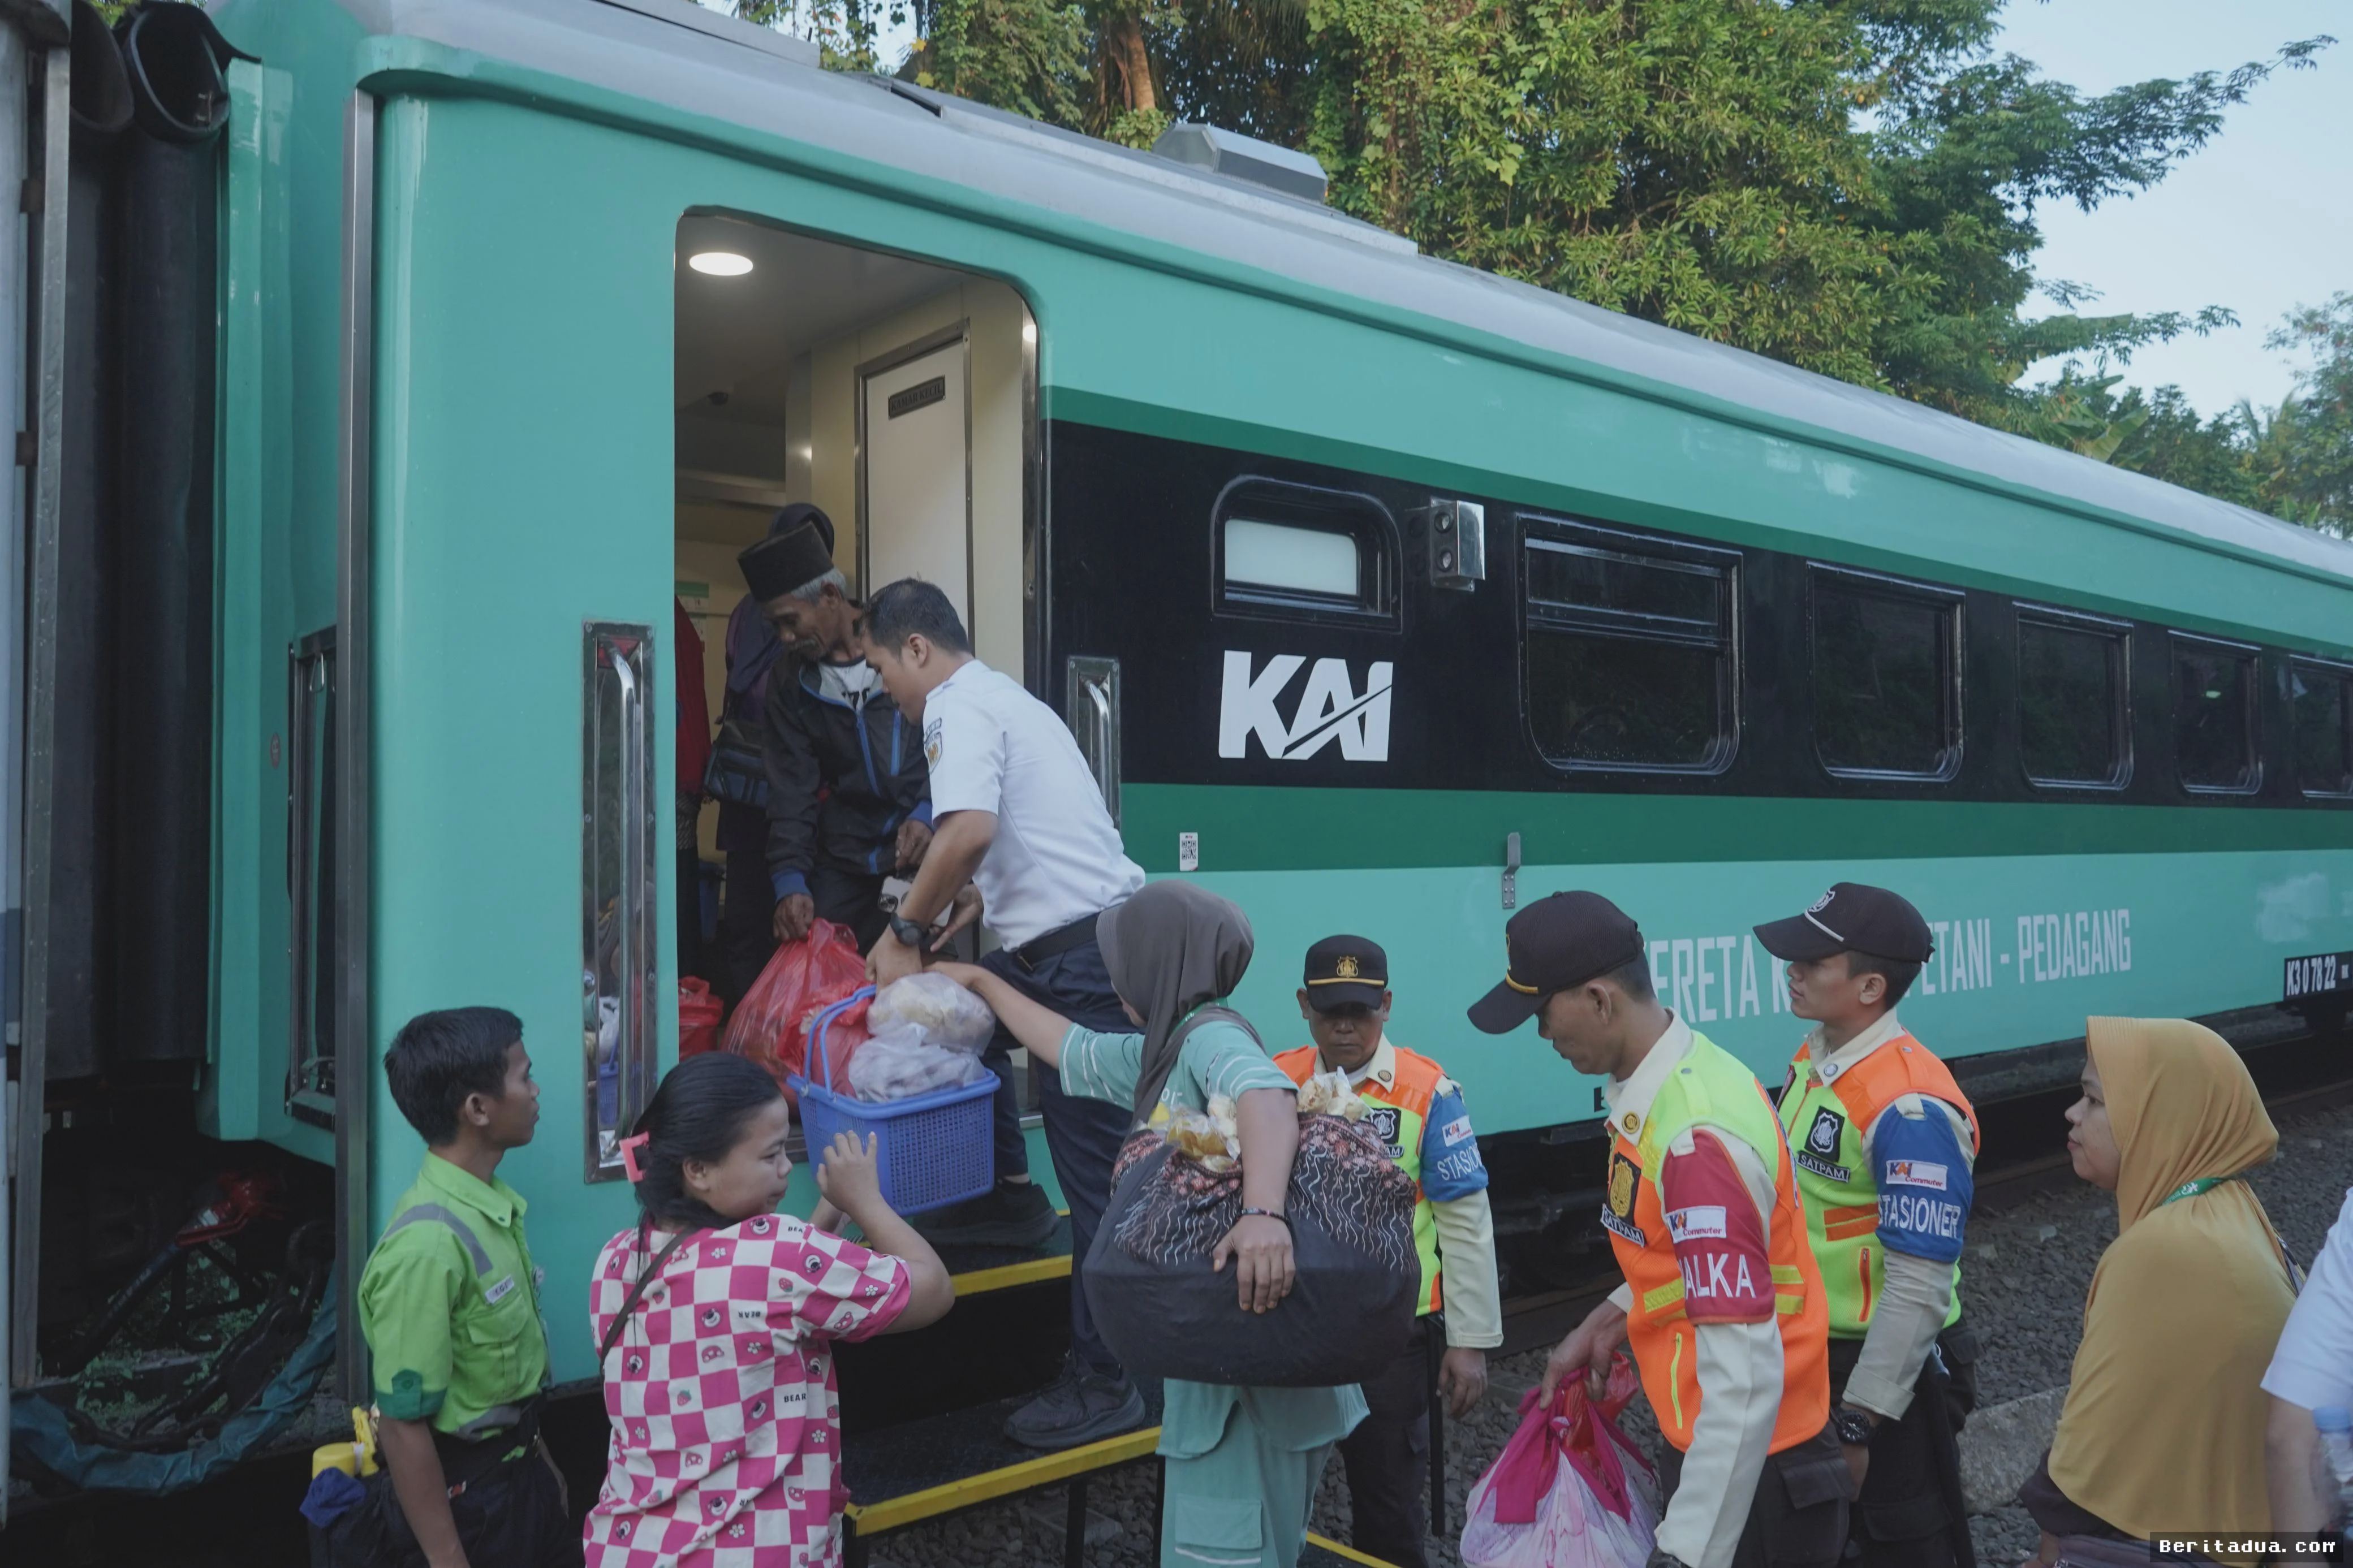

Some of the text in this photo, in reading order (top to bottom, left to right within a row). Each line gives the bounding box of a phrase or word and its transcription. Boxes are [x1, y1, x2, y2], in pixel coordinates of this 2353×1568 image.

[891, 392, 917, 412] KAMAR
[1218, 650, 1393, 762] KAI
[1644, 935, 1761, 1023] ERETA
[1904, 918, 1992, 997] ETANI
[2018, 909, 2131, 984] PEDAGANG
[2287, 960, 2300, 996] K3
[1800, 1155, 1845, 1180] SATPAM
[1890, 1162, 1913, 1177] KAI
[1904, 1176, 1943, 1187] Commuter
[1604, 1210, 1641, 1242] SATPAM
[1669, 1211, 1688, 1232] KAI
[1683, 1228, 1722, 1237] Commuter
[1678, 1252, 1757, 1300] ALKA
[784, 1393, 807, 1403] BEAR
